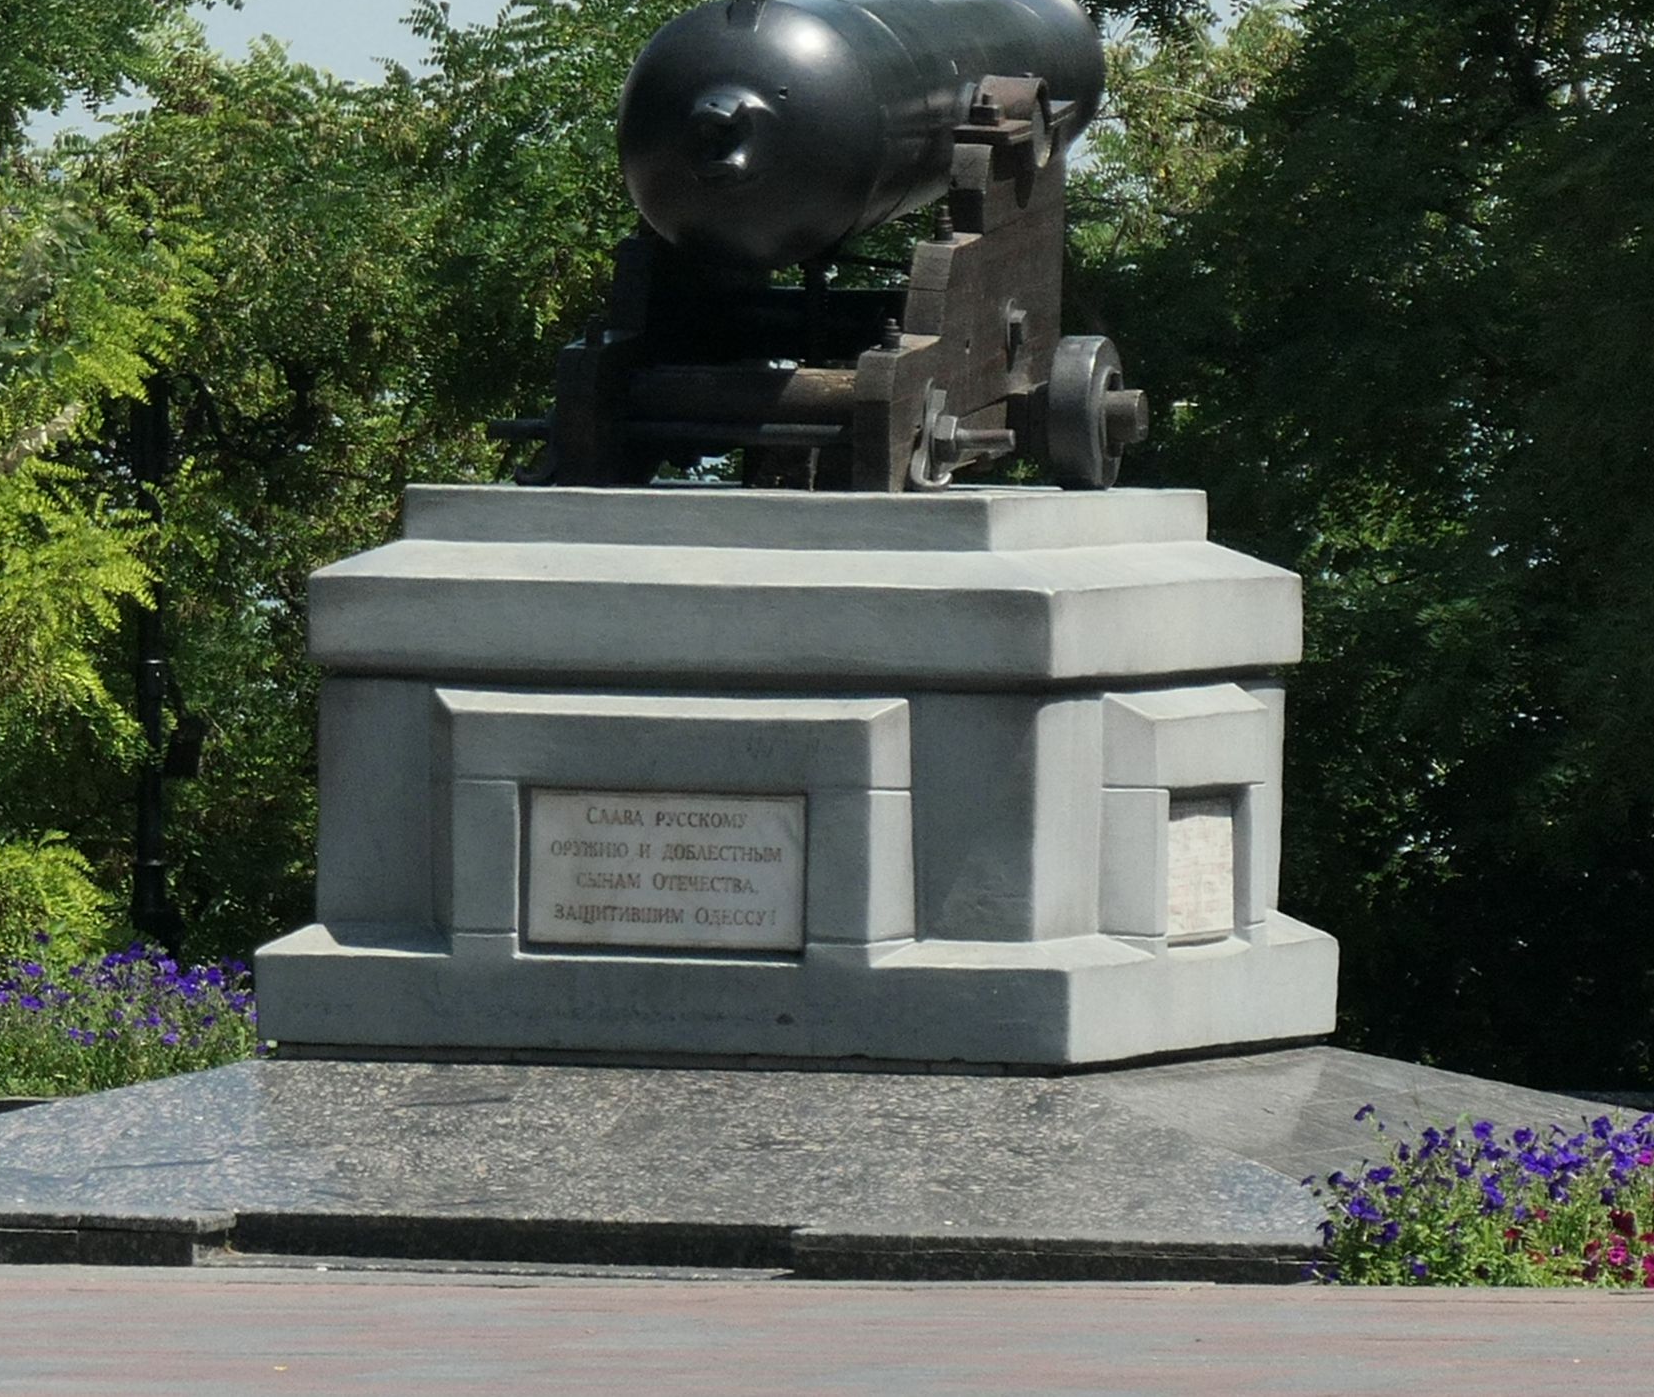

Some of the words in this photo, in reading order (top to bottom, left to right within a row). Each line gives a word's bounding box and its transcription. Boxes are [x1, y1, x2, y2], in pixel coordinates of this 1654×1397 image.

[638, 843, 652, 860] И
[662, 843, 783, 863] ДОБЛЕСТНЫМ
[575, 873, 642, 890] СЫНАМ
[554, 904, 685, 925] ЗАЩИТИВШИМ
